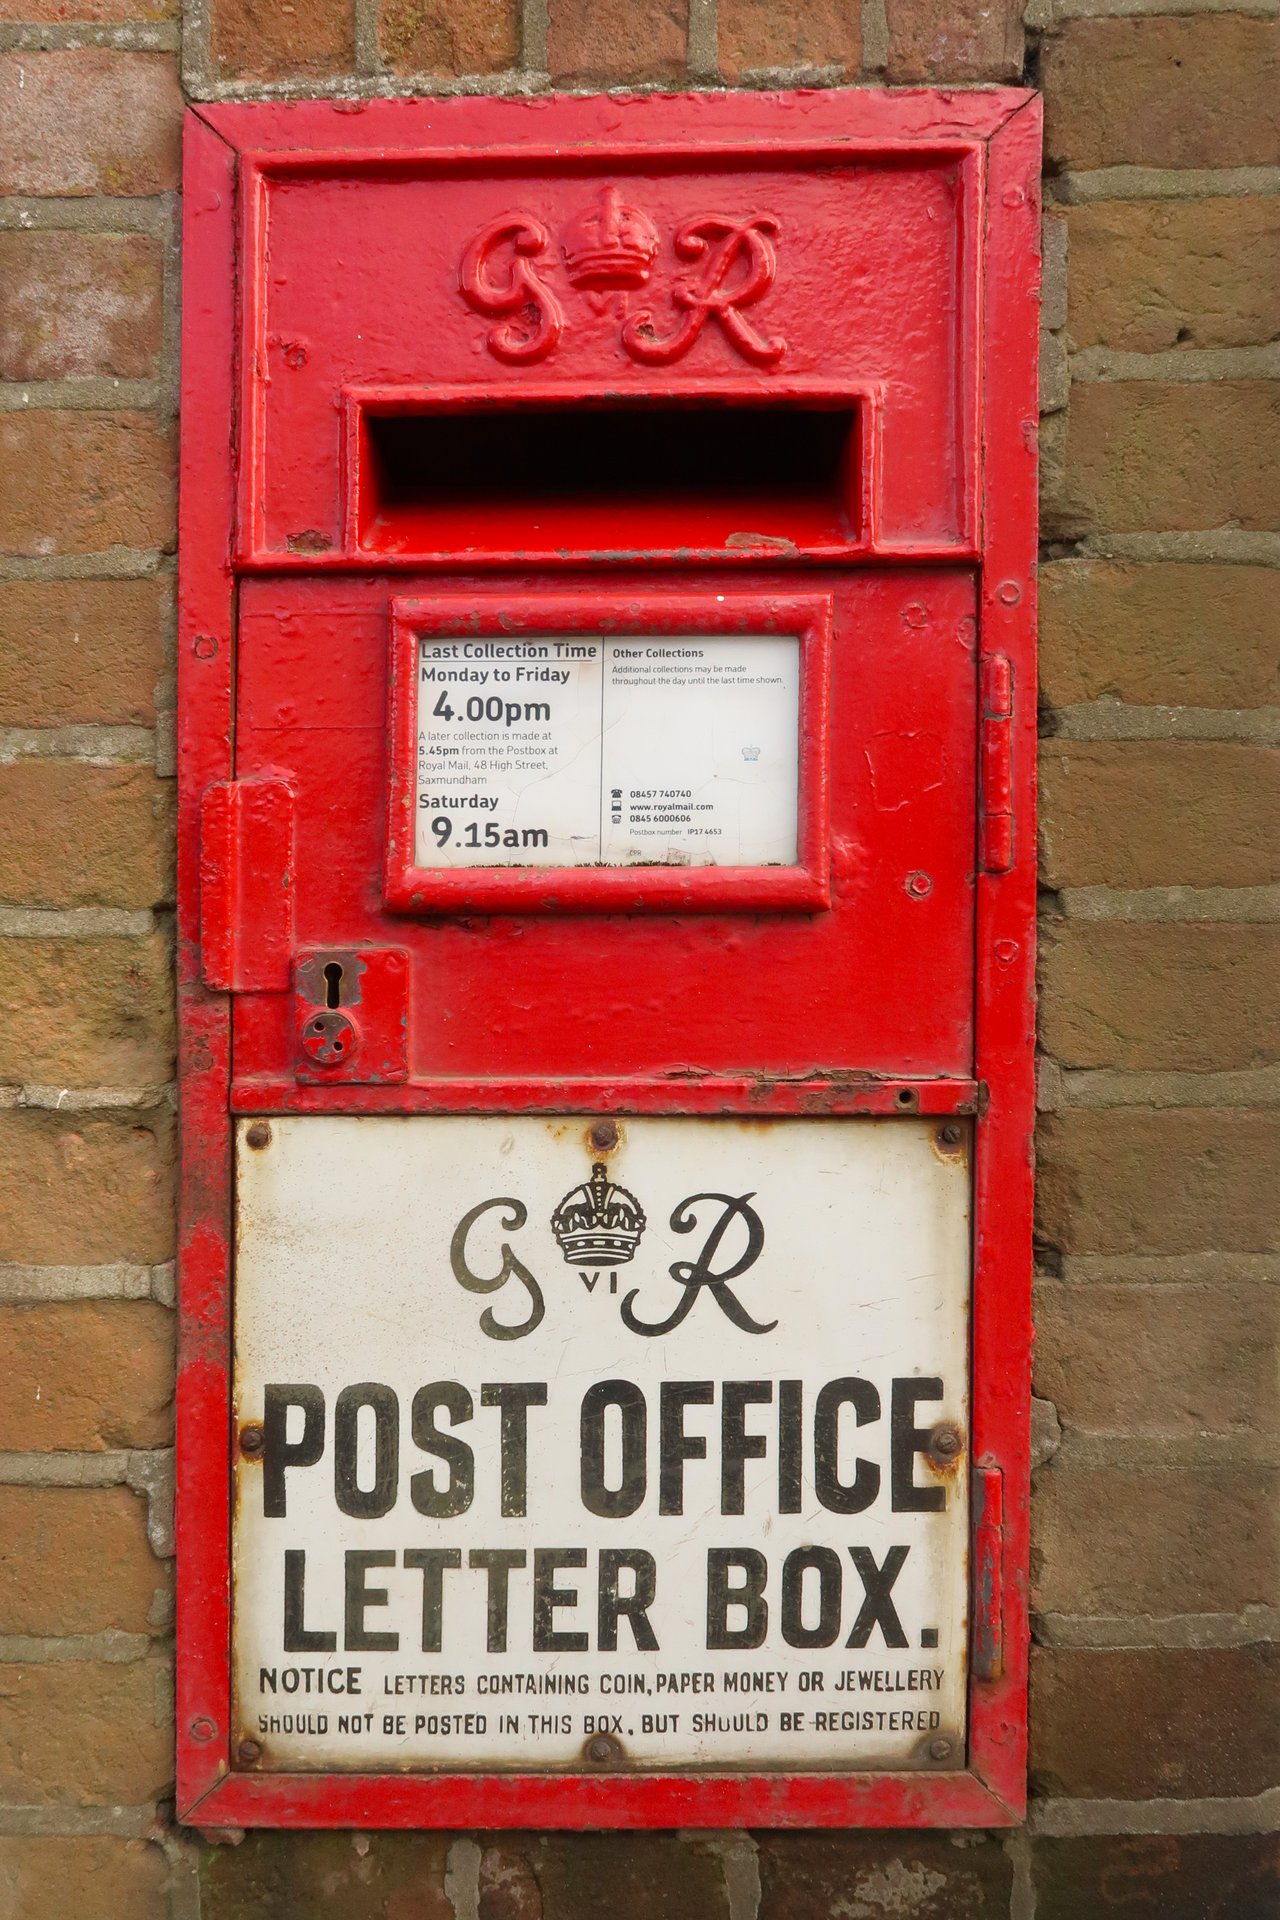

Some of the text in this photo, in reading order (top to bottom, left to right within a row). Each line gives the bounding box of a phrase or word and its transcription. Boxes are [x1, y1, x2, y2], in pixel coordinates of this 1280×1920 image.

[421, 641, 597, 659] Last Collection Time
[613, 648, 704, 658] Other Collections
[421, 667, 570, 685] Monday to Friday
[612, 665, 651, 674] Additional
[652, 665, 693, 673] collections
[695, 666, 712, 674] may
[612, 677, 656, 686] throughout
[658, 677, 671, 685] the
[672, 676, 686, 685] day
[688, 676, 705, 684] until
[707, 676, 719, 684] the
[721, 675, 735, 684] last
[737, 675, 755, 683] time
[433, 690, 550, 727] 4.00pm
[419, 731, 552, 740] A later collection is made at
[419, 745, 558, 757] 5.45pm from the Postbox at
[418, 760, 549, 772] Royal Mail, 48 High Street,
[418, 775, 487, 785] Saxmundham
[630, 790, 692, 798] 08457 740740
[419, 794, 499, 811] Saturday
[630, 803, 714, 812] www.royalmail.com
[629, 814, 692, 823] 0845 6000606
[431, 816, 549, 849] 9.15am
[687, 828, 703, 836] IP17
[450, 1192, 778, 1341] G R
[578, 1271, 617, 1293] VI
[263, 1377, 946, 1518] POST OFFICE
[283, 1545, 939, 1654] LETTER BOX.
[259, 1667, 945, 1696] NOTICE LETTERS CONTAINING COIN, PAPER MONEY OR JEWELLERY
[259, 1714, 328, 1735] SHOULD
[338, 1713, 374, 1735] NOT
[382, 1714, 407, 1735] BE
[414, 1713, 487, 1735] POSTED
[499, 1714, 520, 1735] IN
[527, 1714, 573, 1735] THIS
[641, 1713, 680, 1734] BUT
[692, 1712, 769, 1733] SHOULD
[779, 1711, 805, 1732] BE
[815, 1710, 942, 1732] REGISTERED
